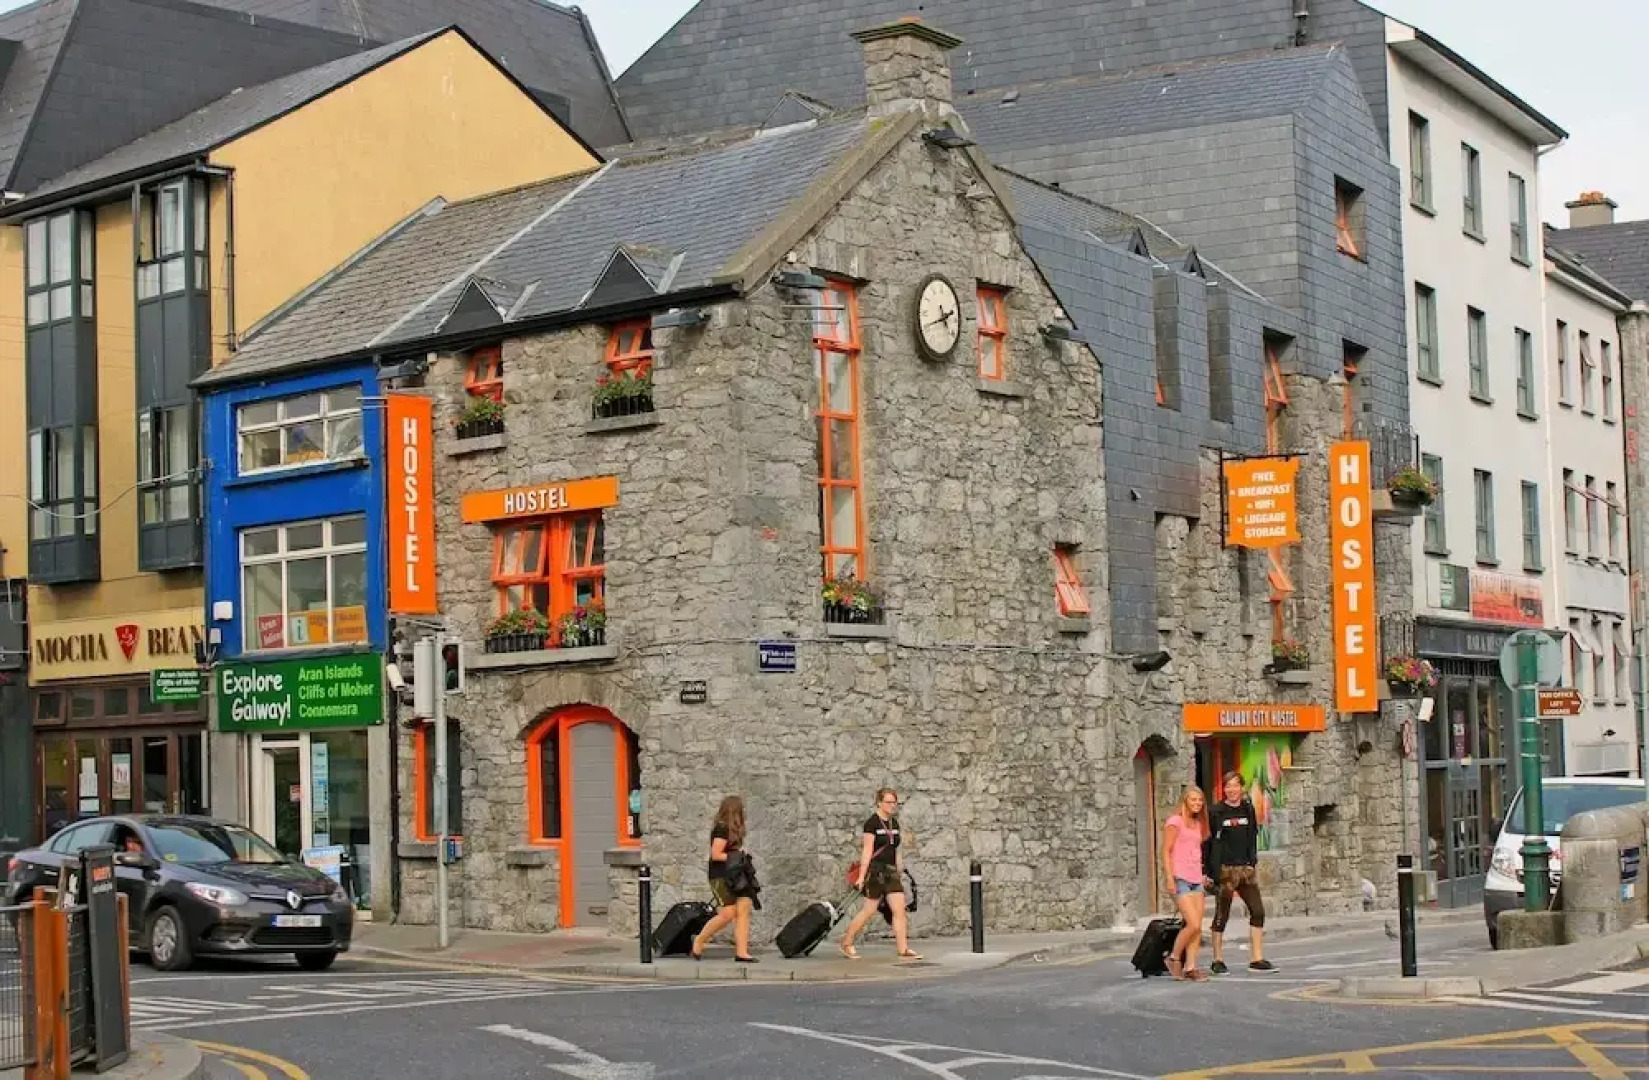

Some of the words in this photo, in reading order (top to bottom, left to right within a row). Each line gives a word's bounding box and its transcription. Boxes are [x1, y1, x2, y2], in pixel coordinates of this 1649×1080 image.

[1251, 470, 1276, 482] FREE
[1237, 484, 1291, 497] BREAKFAST
[402, 417, 420, 592] HOSTEL
[504, 487, 568, 514] HOSTEL
[1244, 512, 1287, 525] LUGGAGE
[1244, 526, 1287, 539] STORAGE
[1338, 454, 1366, 698] HOSTEL
[36, 632, 108, 665] MOCHA
[298, 667, 324, 682] Aran
[324, 663, 364, 680] Islands
[222, 667, 284, 699] Explore
[298, 684, 325, 700] Cliffs
[327, 683, 339, 698] of
[340, 681, 375, 697] Moher
[231, 694, 291, 726] Galway!
[298, 703, 359, 718] Connemara
[1221, 709, 1249, 727] GALWAY
[1252, 709, 1267, 727] CITY
[1271, 709, 1299, 727] HOSTEL
